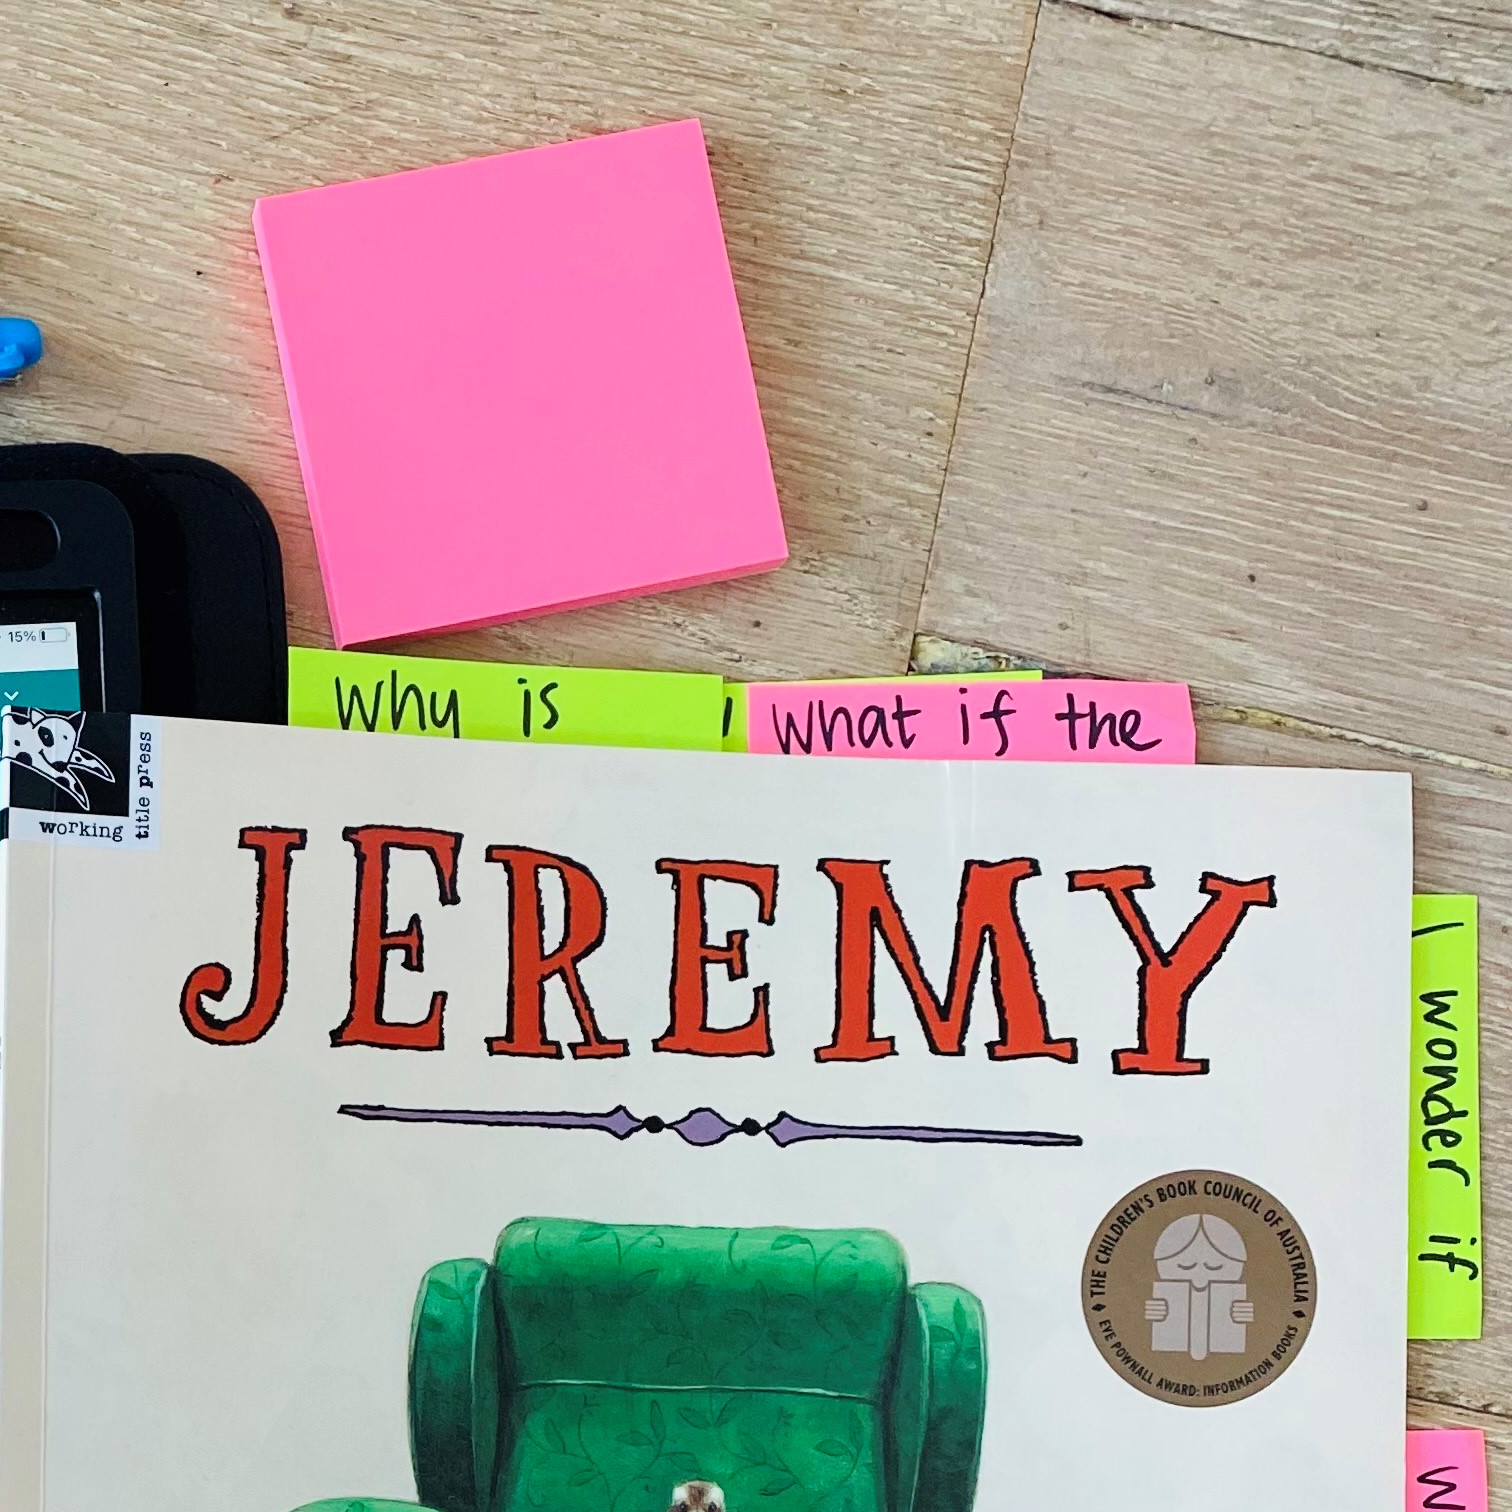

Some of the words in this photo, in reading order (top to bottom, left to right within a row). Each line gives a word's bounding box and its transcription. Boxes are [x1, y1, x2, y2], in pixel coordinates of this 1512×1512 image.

[7, 630, 36, 642] 15%
[336, 669, 459, 738] Why
[517, 678, 560, 737] is
[959, 687, 1017, 756] if
[1055, 692, 1162, 752] the
[139, 731, 153, 788] press
[39, 821, 123, 842] working
[135, 796, 150, 839] title
[180, 823, 1276, 1076] JEREMY
[1419, 989, 1471, 1186] wonder
[1090, 1269, 1106, 1298] THE
[1156, 1180, 1197, 1202] BOOK
[1203, 1181, 1260, 1214] COUNCIL
[1264, 1209, 1283, 1228] OF
[1277, 1228, 1309, 1303] AUSTRALIA
[1418, 1234, 1478, 1280] if
[1099, 1319, 1116, 1341] EVE
[1111, 1341, 1153, 1385] POWNALL
[1203, 1358, 1275, 1396] INFORMATION
[1271, 1325, 1299, 1361] BOOKS
